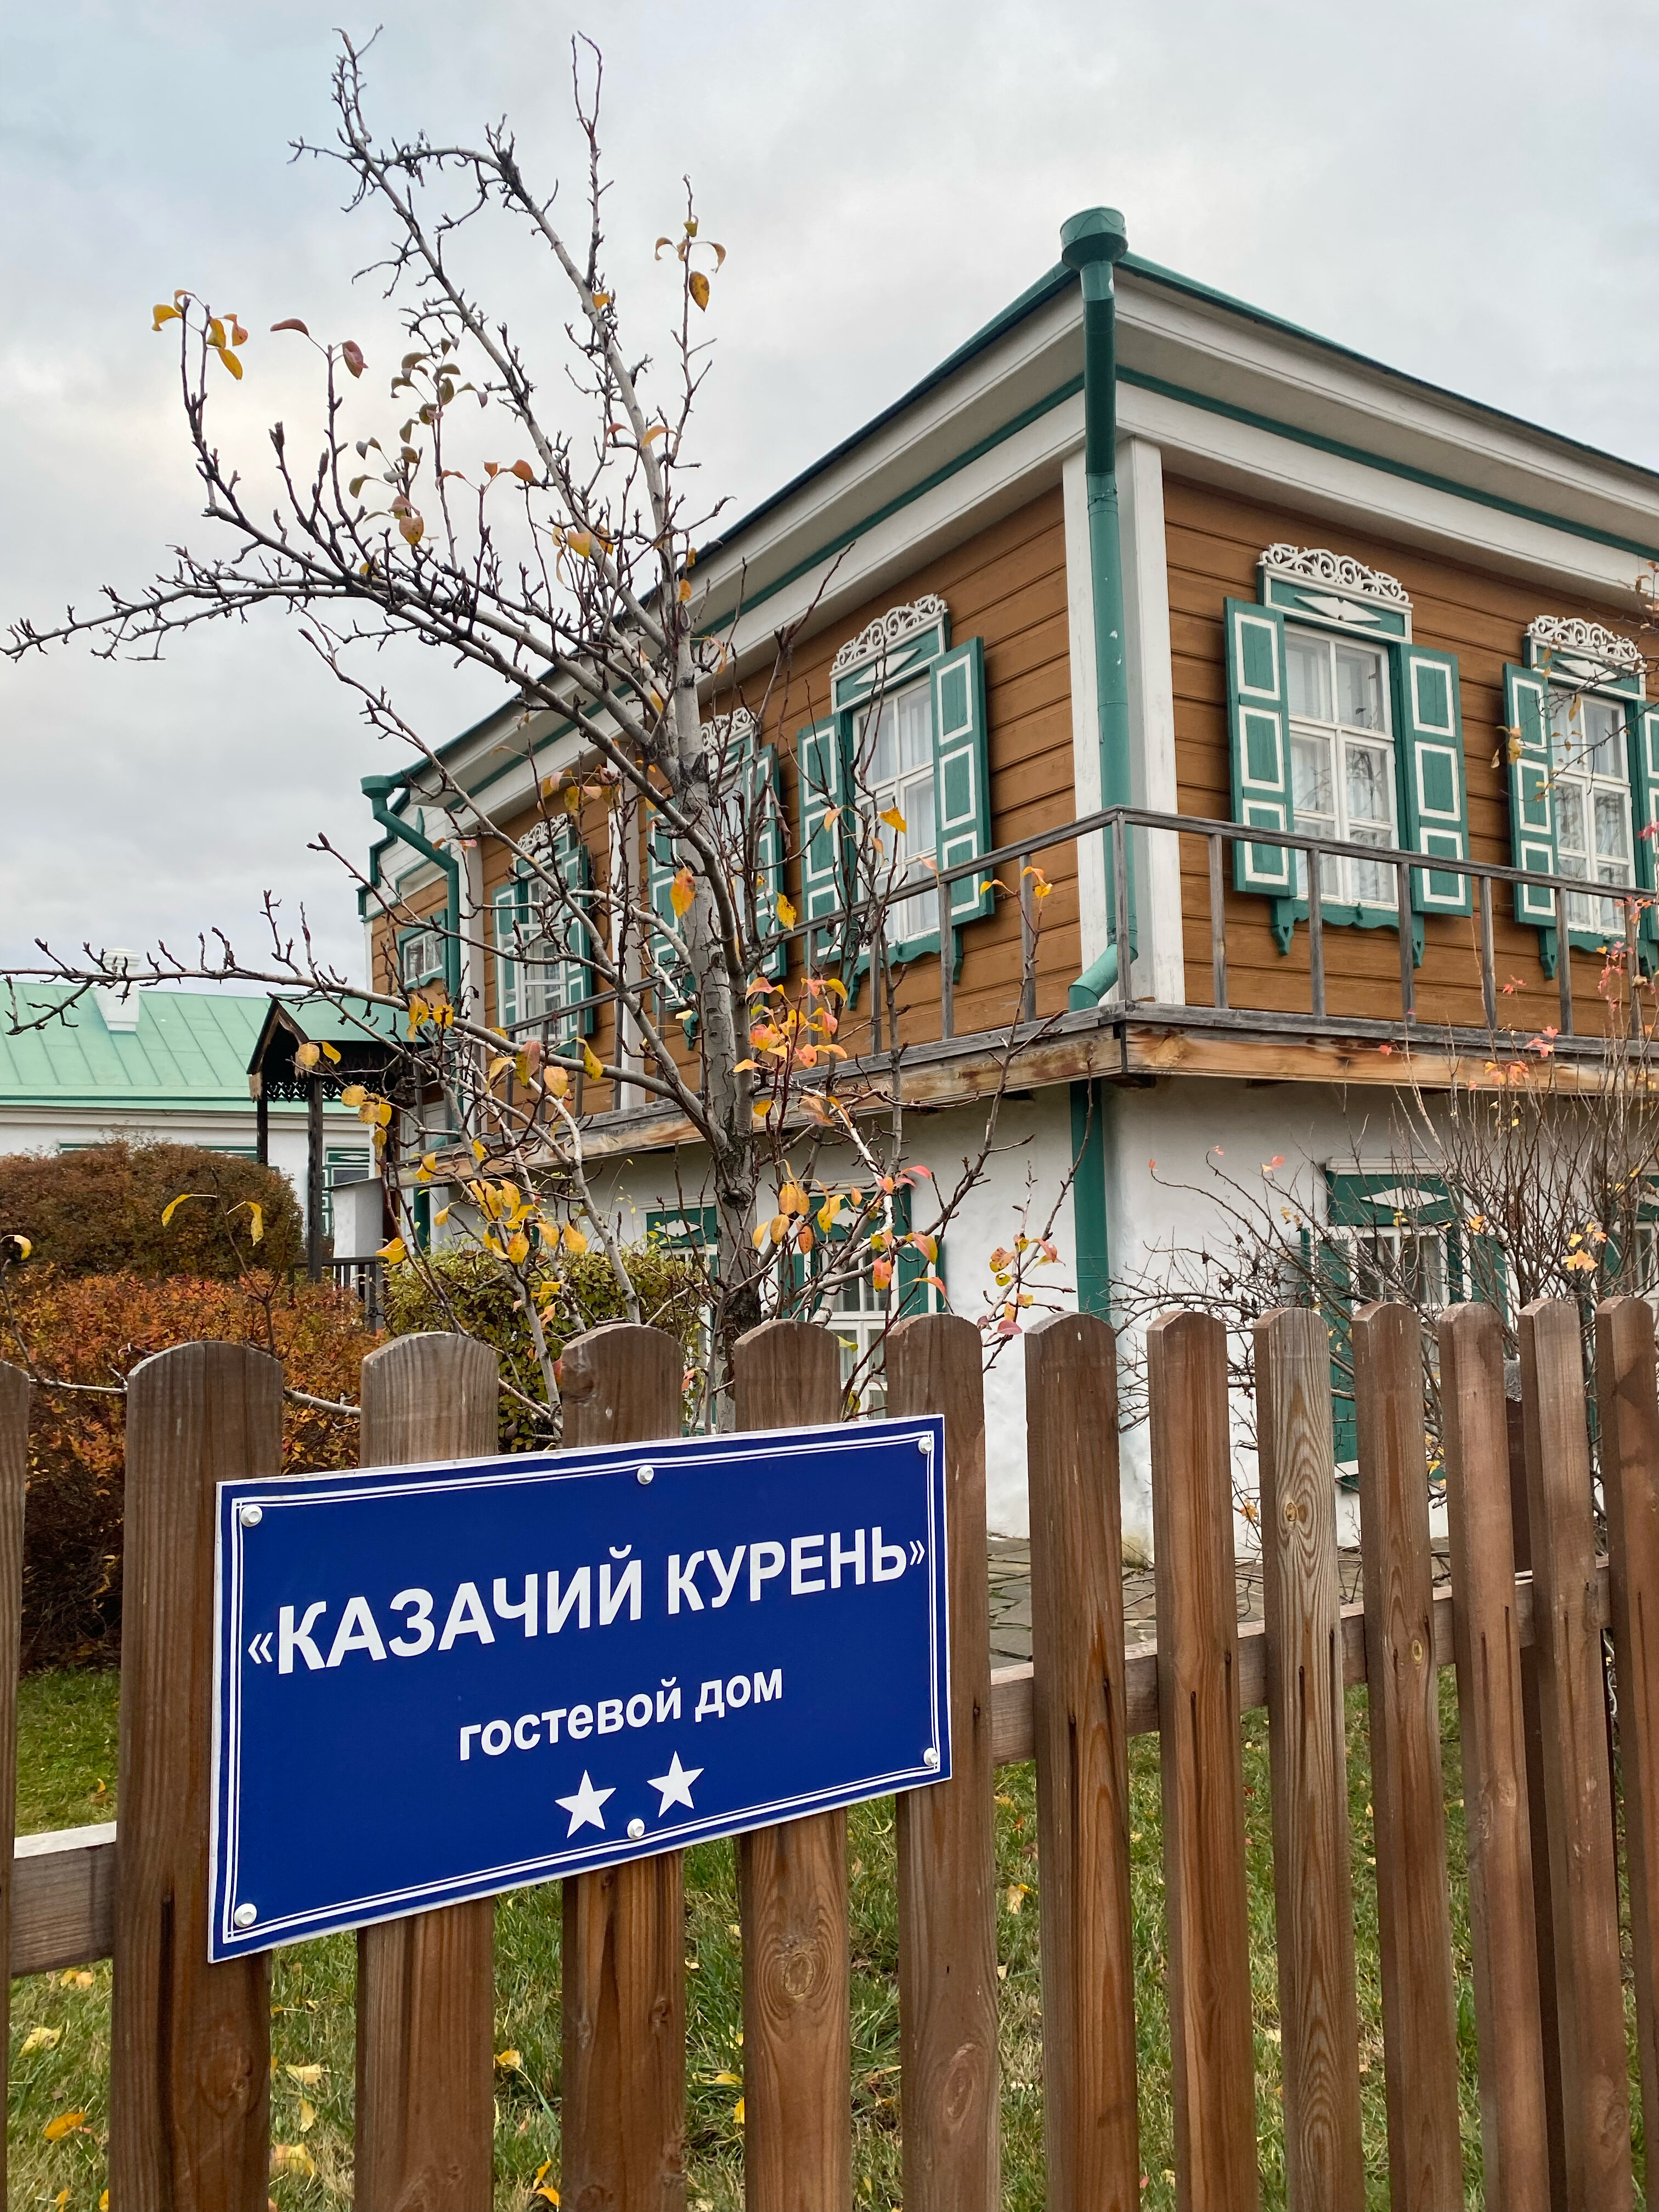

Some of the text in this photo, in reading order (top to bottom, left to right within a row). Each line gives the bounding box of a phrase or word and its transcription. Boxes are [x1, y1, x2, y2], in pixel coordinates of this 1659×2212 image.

[248, 1526, 926, 1674] «КАЗАЧИЙ КУРЕНЬ»
[460, 1668, 782, 1761] гостевой дом
